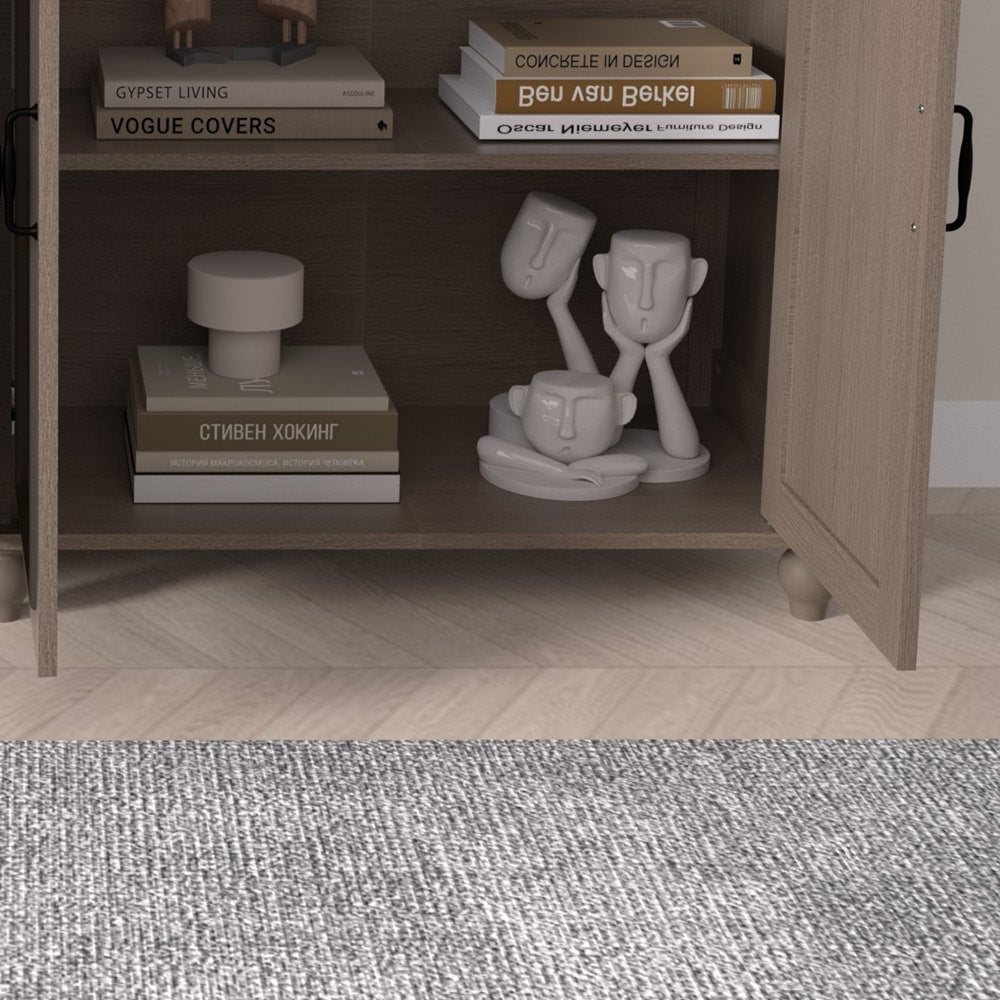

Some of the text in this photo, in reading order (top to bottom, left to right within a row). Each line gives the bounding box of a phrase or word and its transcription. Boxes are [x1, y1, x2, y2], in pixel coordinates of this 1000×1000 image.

[116, 86, 228, 100] GYPSET LIVING
[111, 117, 276, 134] VOGUE COVERS
[199, 423, 339, 441] СТИВЕН ХОКИНГ
[170, 459, 209, 467] ИСТОРИЯ
[282, 459, 320, 467] ИСТОРИЯ
[323, 459, 365, 467] ЧЕЛОВЕКА
